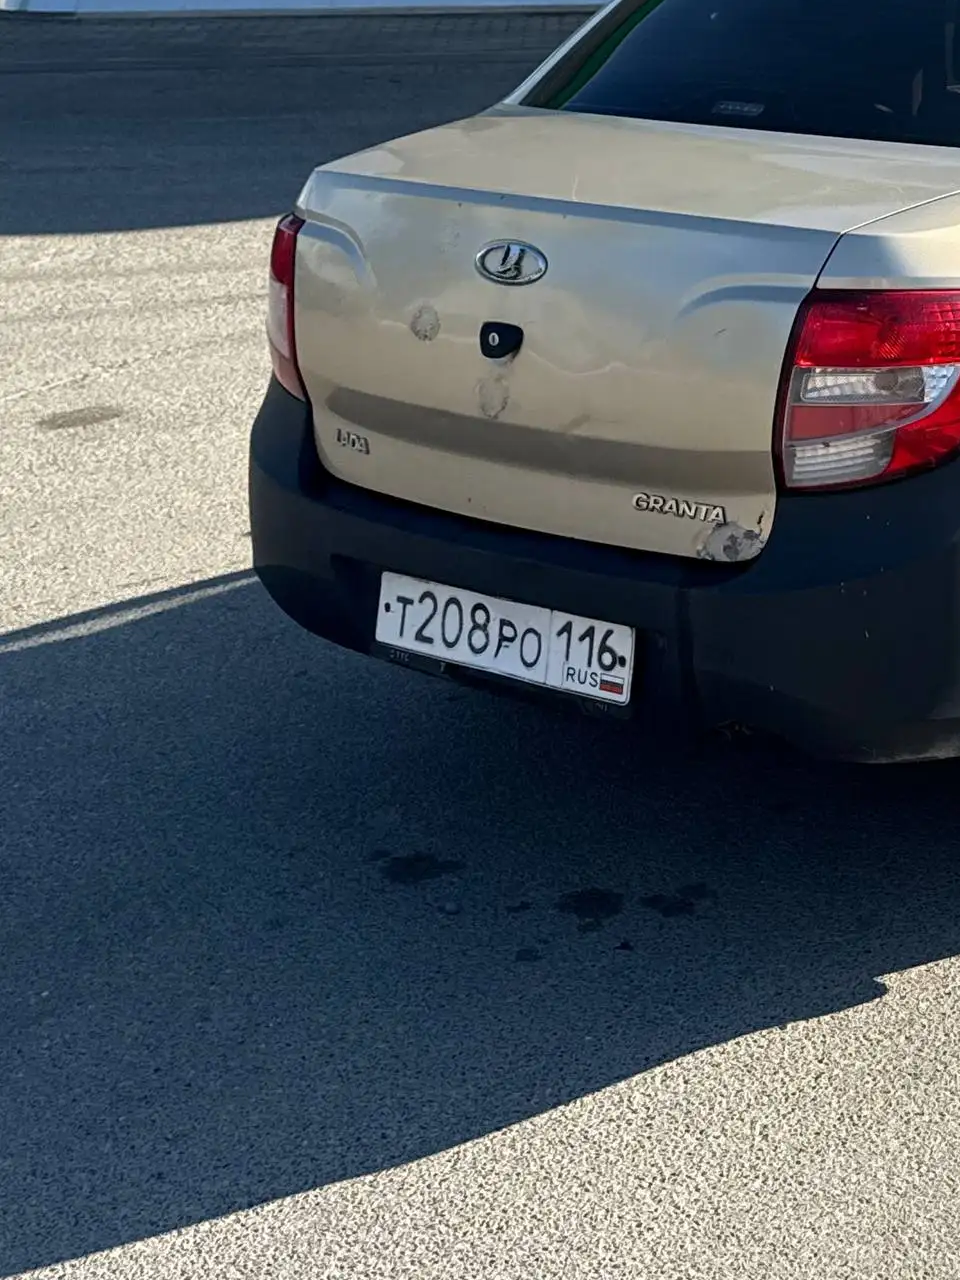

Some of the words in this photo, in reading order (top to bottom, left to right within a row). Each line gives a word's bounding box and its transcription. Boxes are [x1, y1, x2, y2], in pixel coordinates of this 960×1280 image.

[336, 428, 370, 455] LADA
[632, 492, 727, 526] GRANTA
[556, 620, 619, 671] 116
[566, 666, 600, 688] RUS
